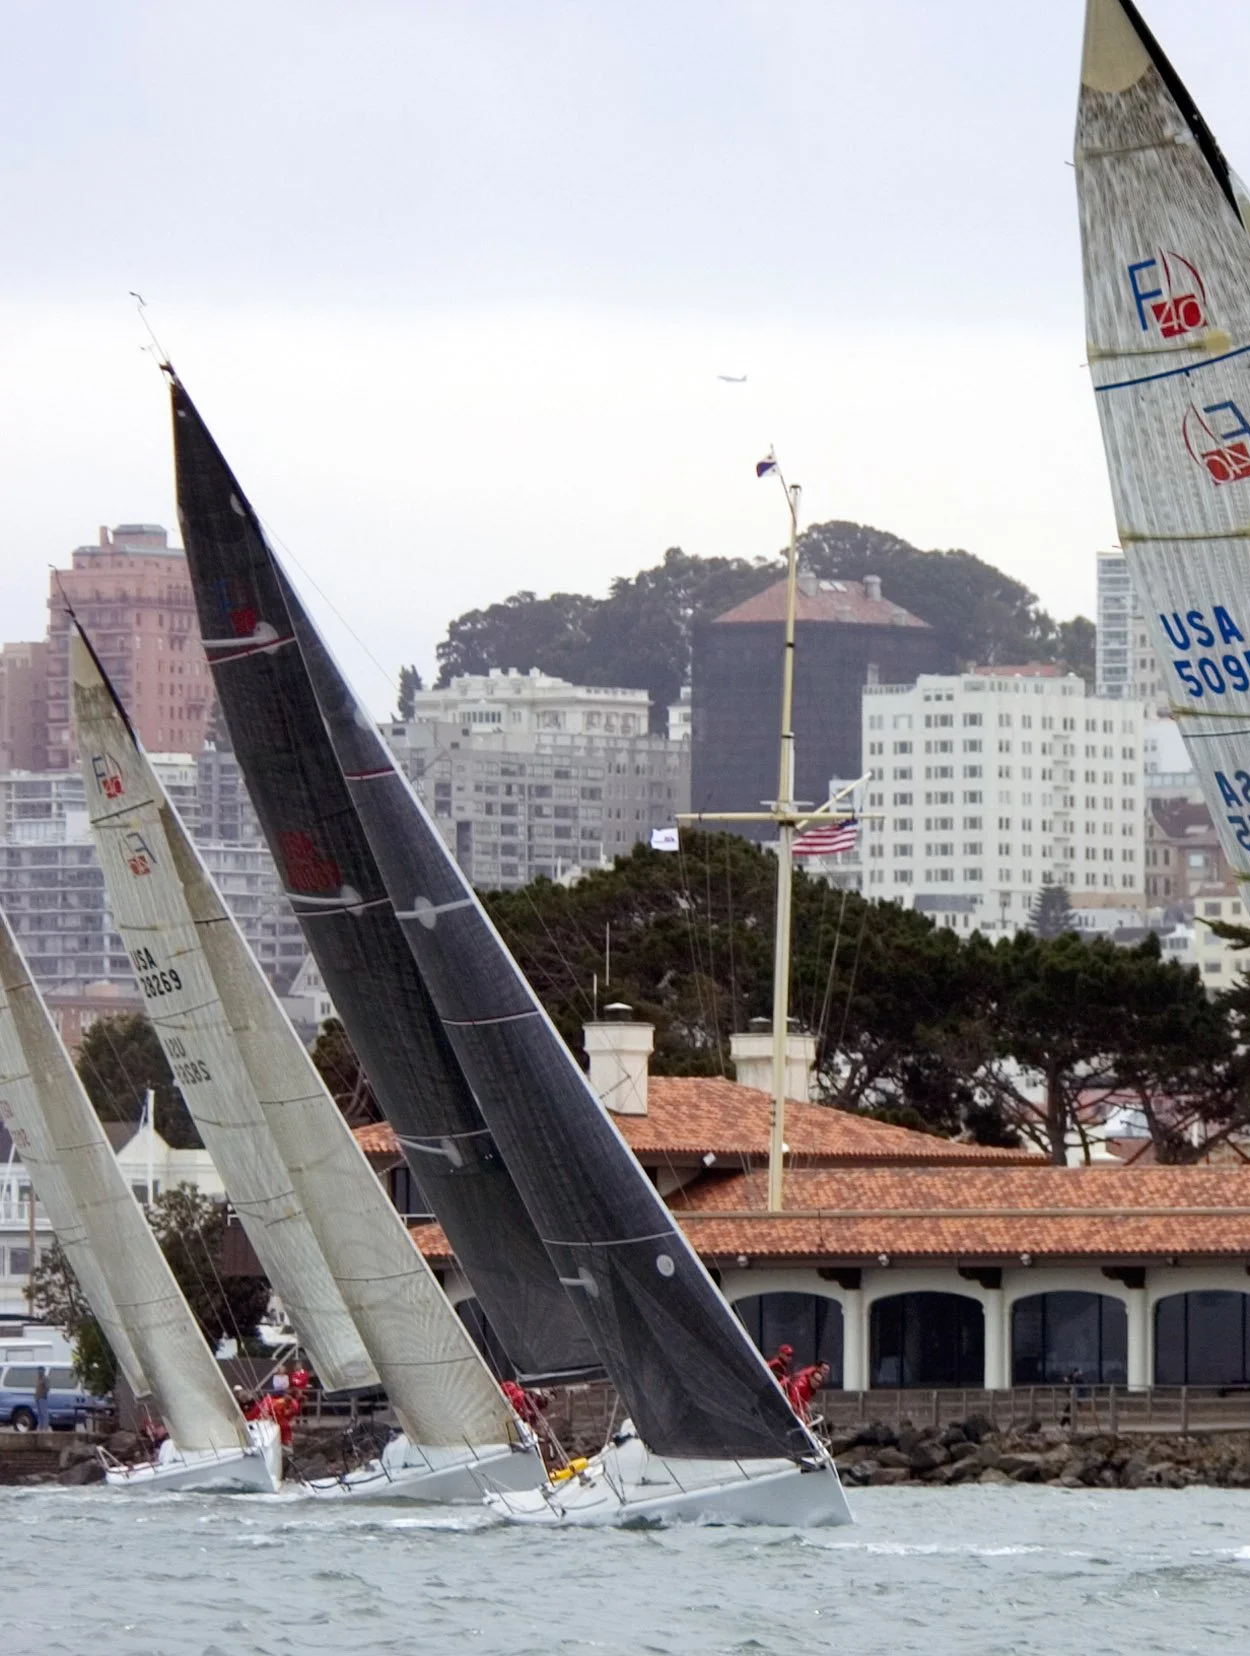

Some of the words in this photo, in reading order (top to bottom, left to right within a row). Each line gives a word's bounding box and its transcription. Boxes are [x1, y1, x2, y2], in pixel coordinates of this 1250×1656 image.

[1159, 605, 1245, 650] USA
[129, 947, 157, 972] USA
[140, 968, 182, 998] 28269
